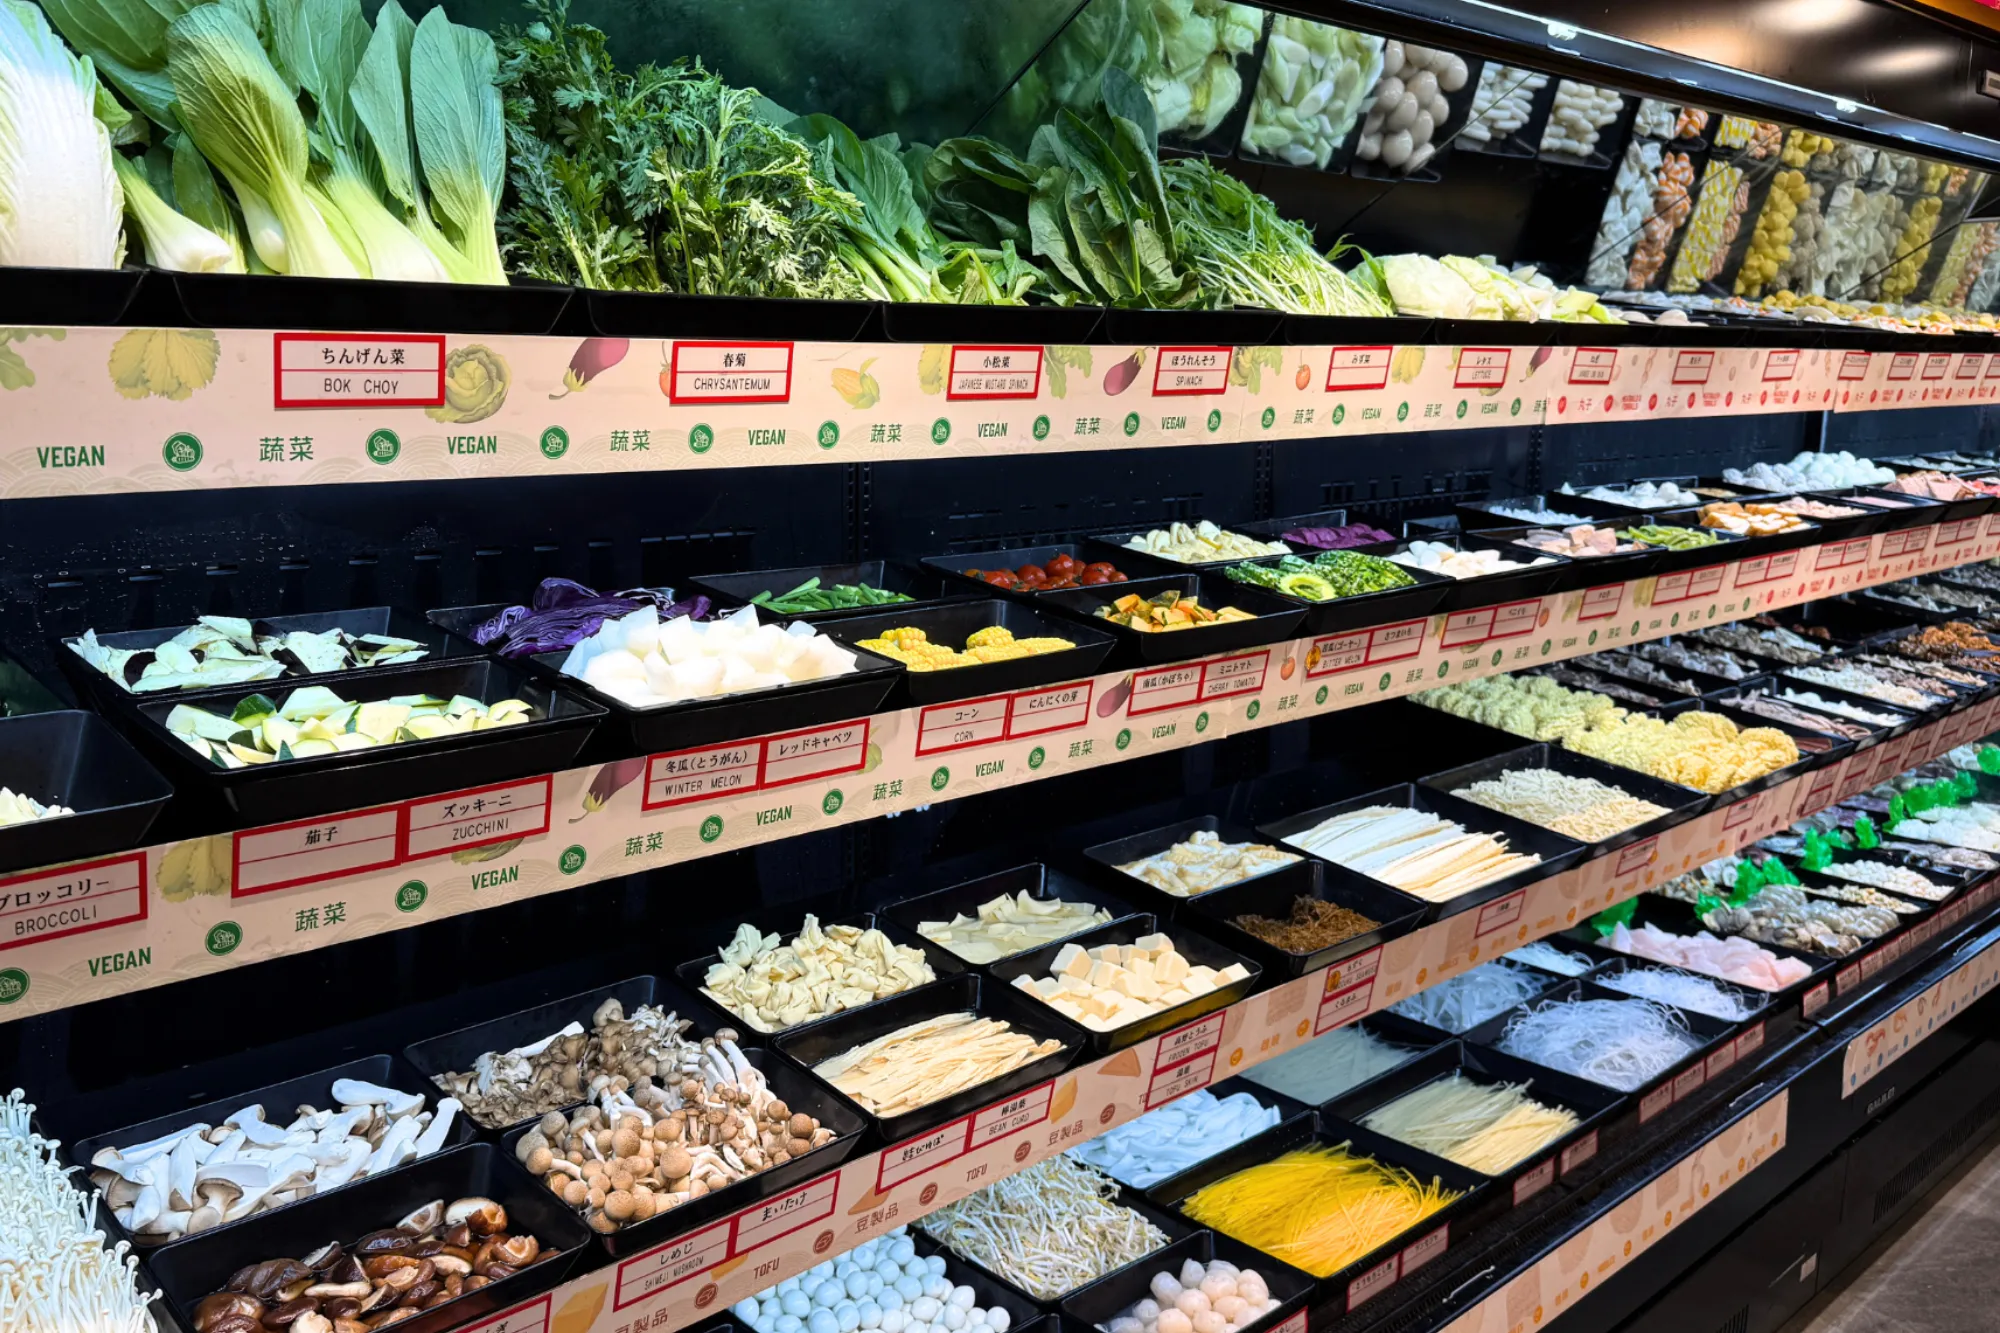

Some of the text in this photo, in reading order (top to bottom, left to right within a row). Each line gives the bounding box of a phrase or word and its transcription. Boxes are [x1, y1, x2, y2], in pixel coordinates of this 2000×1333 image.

[321, 347, 405, 366] ちんげん菜
[723, 353, 746, 368] 春菊
[983, 355, 1011, 369] 小松菜
[1171, 354, 1216, 367] ほうれんそう
[324, 378, 399, 394] BOK CHOY
[694, 377, 771, 391] CHRYSANTEMUM
[1175, 376, 1203, 387] SPINACH
[1293, 409, 1315, 425] 蔬菜
[1361, 408, 1382, 420] VEGAN
[1424, 404, 1442, 418] 蔬菜
[1481, 403, 1498, 415] VEGAN
[977, 423, 1008, 438] VEGAN
[1074, 417, 1101, 436] 蔬菜
[1161, 416, 1186, 430] VEGAN
[610, 430, 651, 452] 蔬菜
[748, 429, 786, 446] VEGAN
[870, 424, 902, 444] 蔬菜
[259, 436, 314, 463] 蔬菜
[447, 435, 498, 455] VEGAN
[36, 445, 105, 469] VEGAN
[1219, 659, 1252, 675] ミニトマト
[1462, 657, 1479, 671] VEGAN
[1208, 676, 1256, 694] CHERRY TOMATO
[1406, 668, 1424, 685] 蔬菜
[1344, 682, 1364, 696] VEGAN
[1029, 690, 1078, 710] にんにくの芽
[1277, 694, 1299, 711] 蔬菜
[955, 709, 979, 722] コーン
[954, 730, 974, 743] CORN
[1152, 723, 1177, 739] VEGAN
[779, 730, 852, 756] レッドキャベツ
[1068, 739, 1094, 759] 蔬菜
[665, 750, 749, 773] 冬瓜(とうがん)
[975, 759, 1004, 777] VEGAN
[665, 774, 742, 796] WINTER MELON
[872, 779, 904, 801] 蔬菜
[442, 794, 513, 819] ズッキーニ
[756, 805, 792, 826] VEGAN
[304, 826, 339, 847] 茄子
[452, 818, 510, 841] ZUCCHINI
[624, 831, 664, 858] 蔬菜
[471, 865, 519, 891] VEGAN
[0, 878, 110, 910] ブロッコリー
[15, 904, 97, 935] BROCCOLI
[294, 901, 347, 933] 蔬菜
[88, 946, 152, 978] VEGAN
[1168, 1038, 1210, 1063] FROZEN TOFU
[1165, 1076, 1199, 1096] TOFU SKIN
[988, 1112, 1030, 1136] BEAN CURD
[1046, 1119, 1084, 1147] 豆製品
[966, 1163, 988, 1183] TOFU
[855, 1202, 898, 1235] 豆製品
[660, 1241, 693, 1265] しめじ
[644, 1255, 704, 1291] SHIMEJI MUSHROOM
[753, 1256, 780, 1280] TOFU
